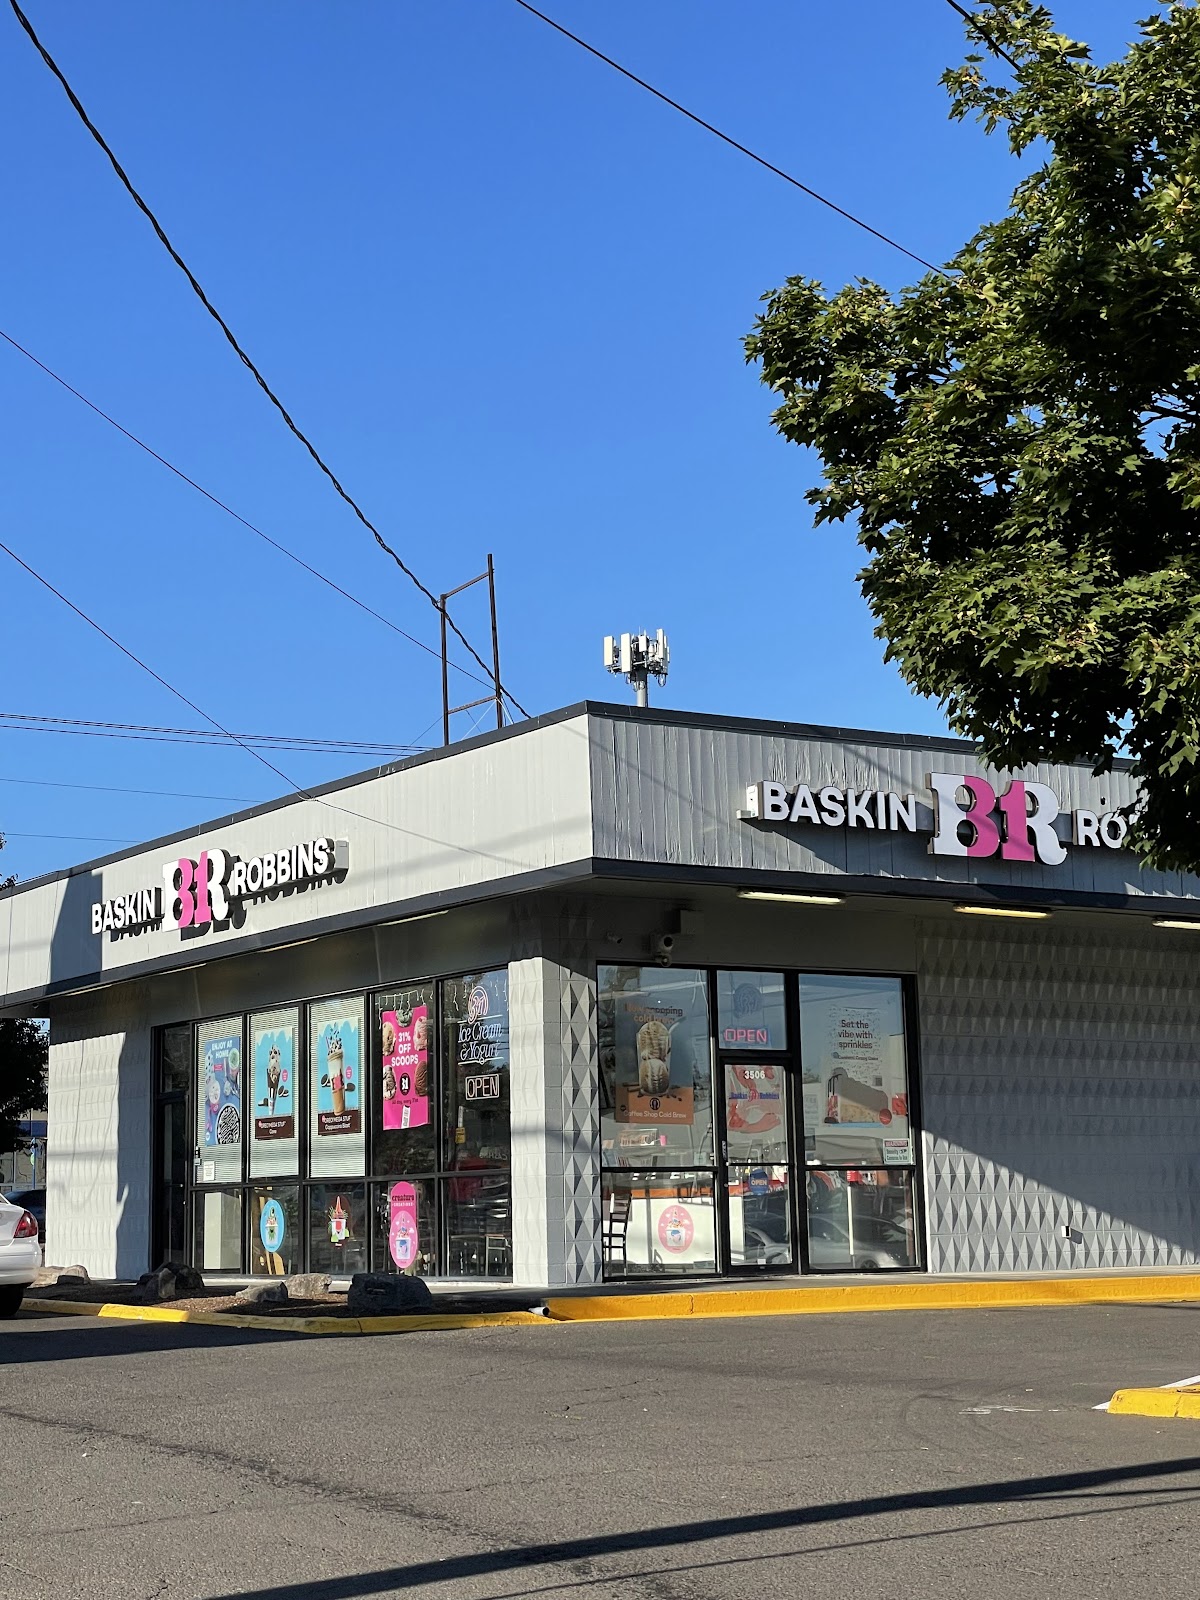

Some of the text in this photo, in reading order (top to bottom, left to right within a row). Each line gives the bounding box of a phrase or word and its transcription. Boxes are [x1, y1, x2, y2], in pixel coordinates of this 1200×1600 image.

[763, 779, 917, 833] BASKIN
[92, 887, 155, 934] BASKIN
[232, 837, 329, 896] ROBBINS
[633, 1014, 651, 1023] cold
[841, 1019, 869, 1029] Set the
[398, 1031, 411, 1042] 31%
[458, 1021, 502, 1042] Ice Cream
[724, 1028, 768, 1043] OPEN
[838, 1029, 873, 1039] vibe with
[211, 1041, 226, 1051] ENJOY
[398, 1043, 411, 1054] OFF
[838, 1039, 873, 1050] sprinkles
[215, 1049, 229, 1059] HOME
[469, 1040, 500, 1065] Yogurt
[391, 1054, 418, 1067] SCOOPS
[744, 1070, 766, 1080] 3506
[467, 1076, 498, 1098] OPEN
[643, 1110, 658, 1118] Shop
[672, 1111, 687, 1119] Brew
[391, 1193, 415, 1202] creature
